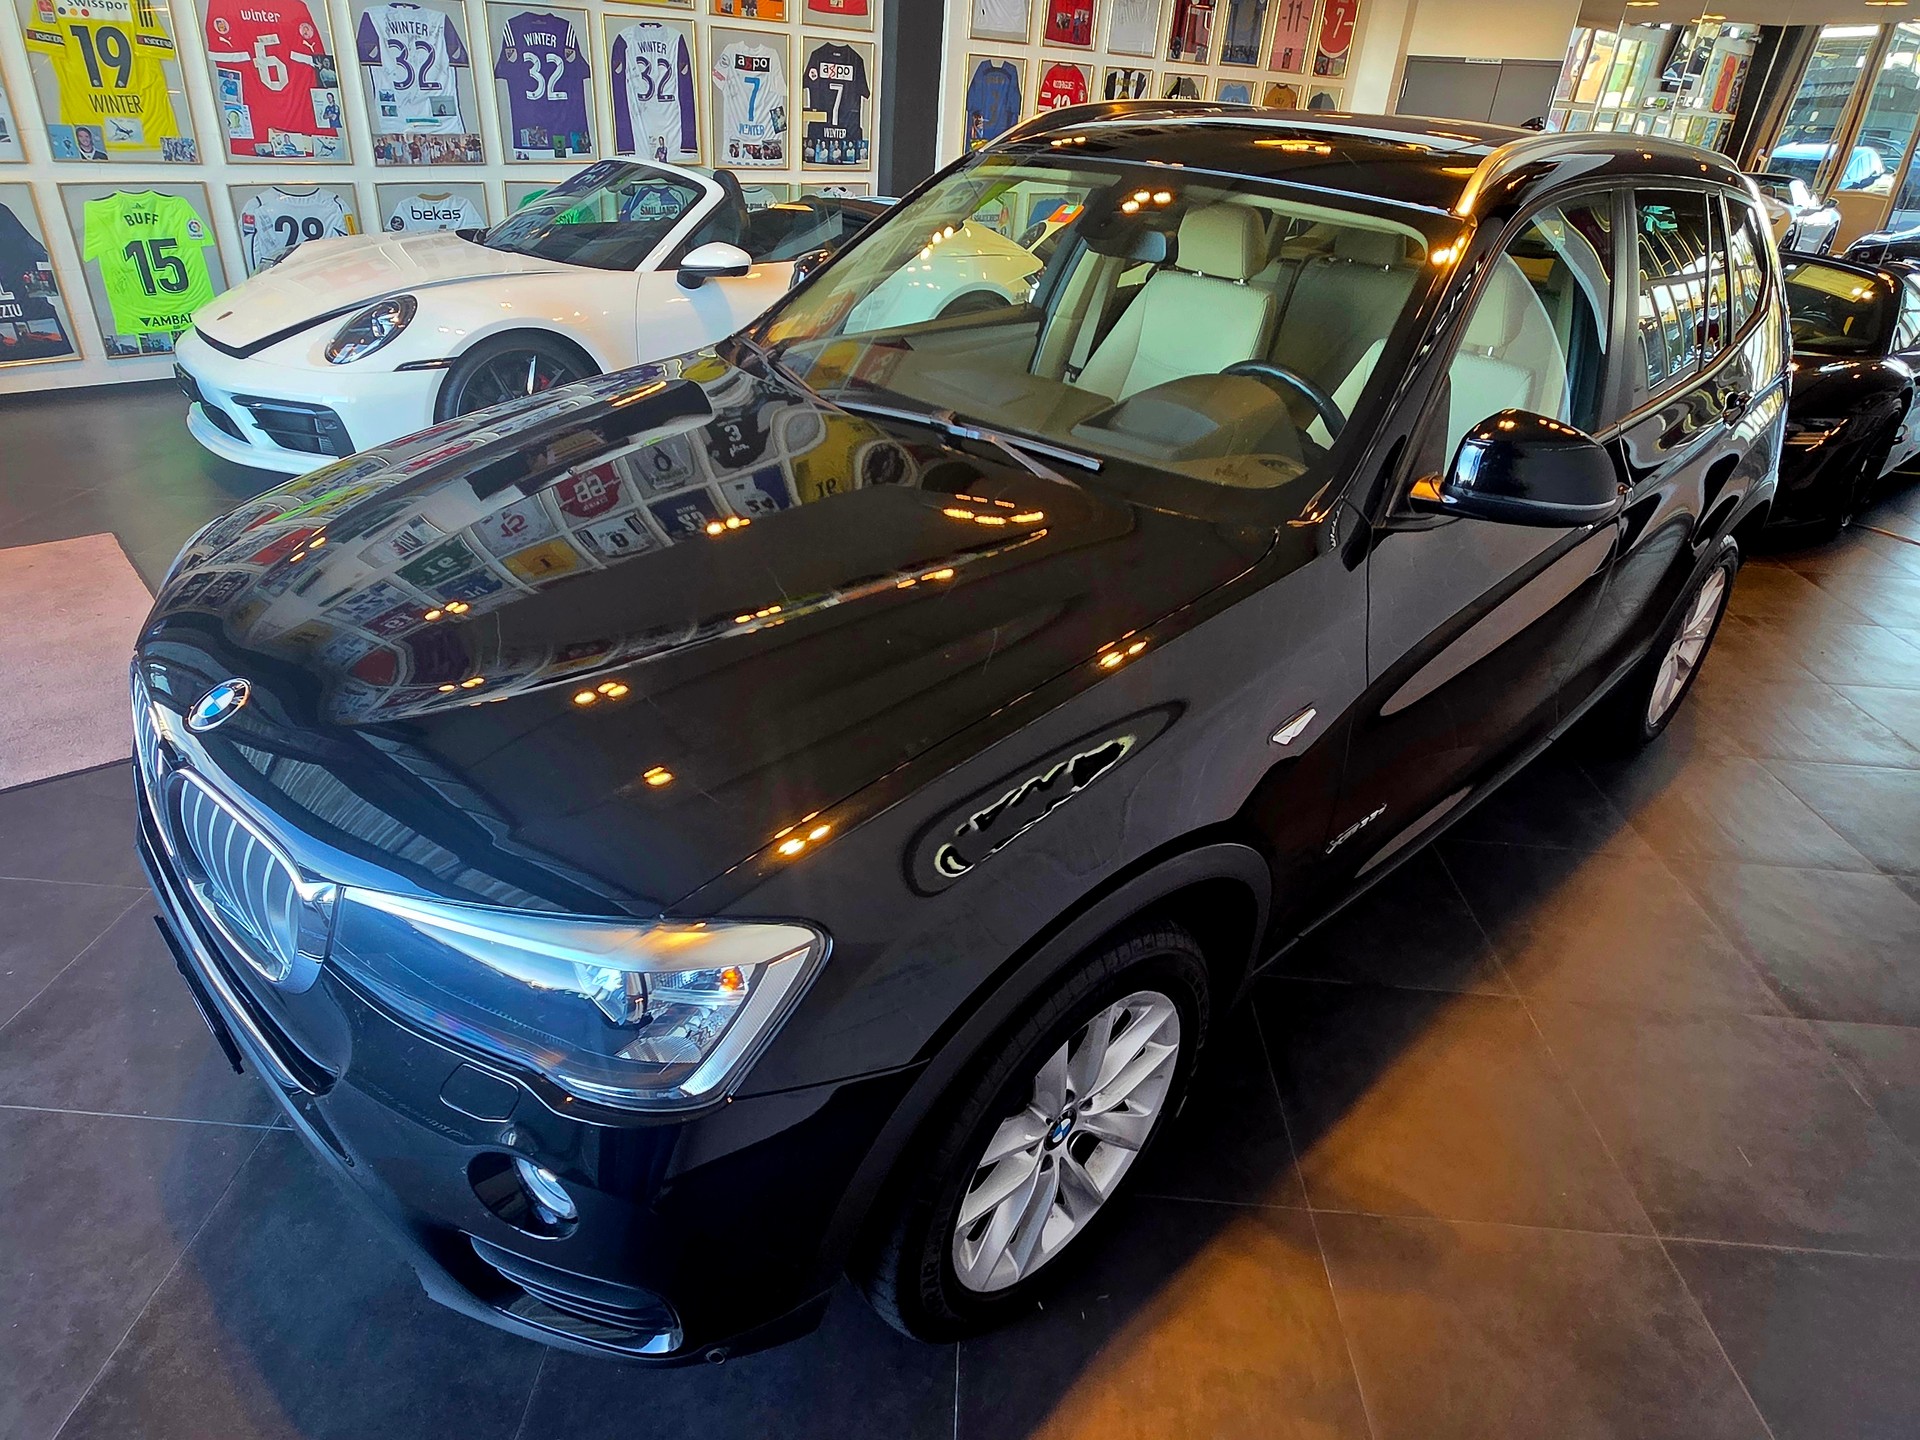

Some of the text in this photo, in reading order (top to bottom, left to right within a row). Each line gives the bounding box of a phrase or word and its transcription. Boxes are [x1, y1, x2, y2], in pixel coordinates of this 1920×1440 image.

[240, 9, 281, 23] winter
[388, 20, 428, 36] WINTER
[69, 24, 132, 89] 19
[523, 32, 557, 48] WINTER
[637, 40, 667, 55] WINTER
[252, 33, 289, 92] 6
[387, 38, 443, 91] 32
[523, 51, 568, 101] 32
[635, 55, 676, 103] 32
[88, 93, 144, 114] WINTER
[743, 76, 761, 122] 7
[828, 83, 844, 126] 7
[738, 122, 766, 136] WINTER
[823, 126, 847, 139] WINTER
[123, 211, 160, 227] BUFF
[252, 214, 325, 248] 28
[122, 237, 190, 297] 15
